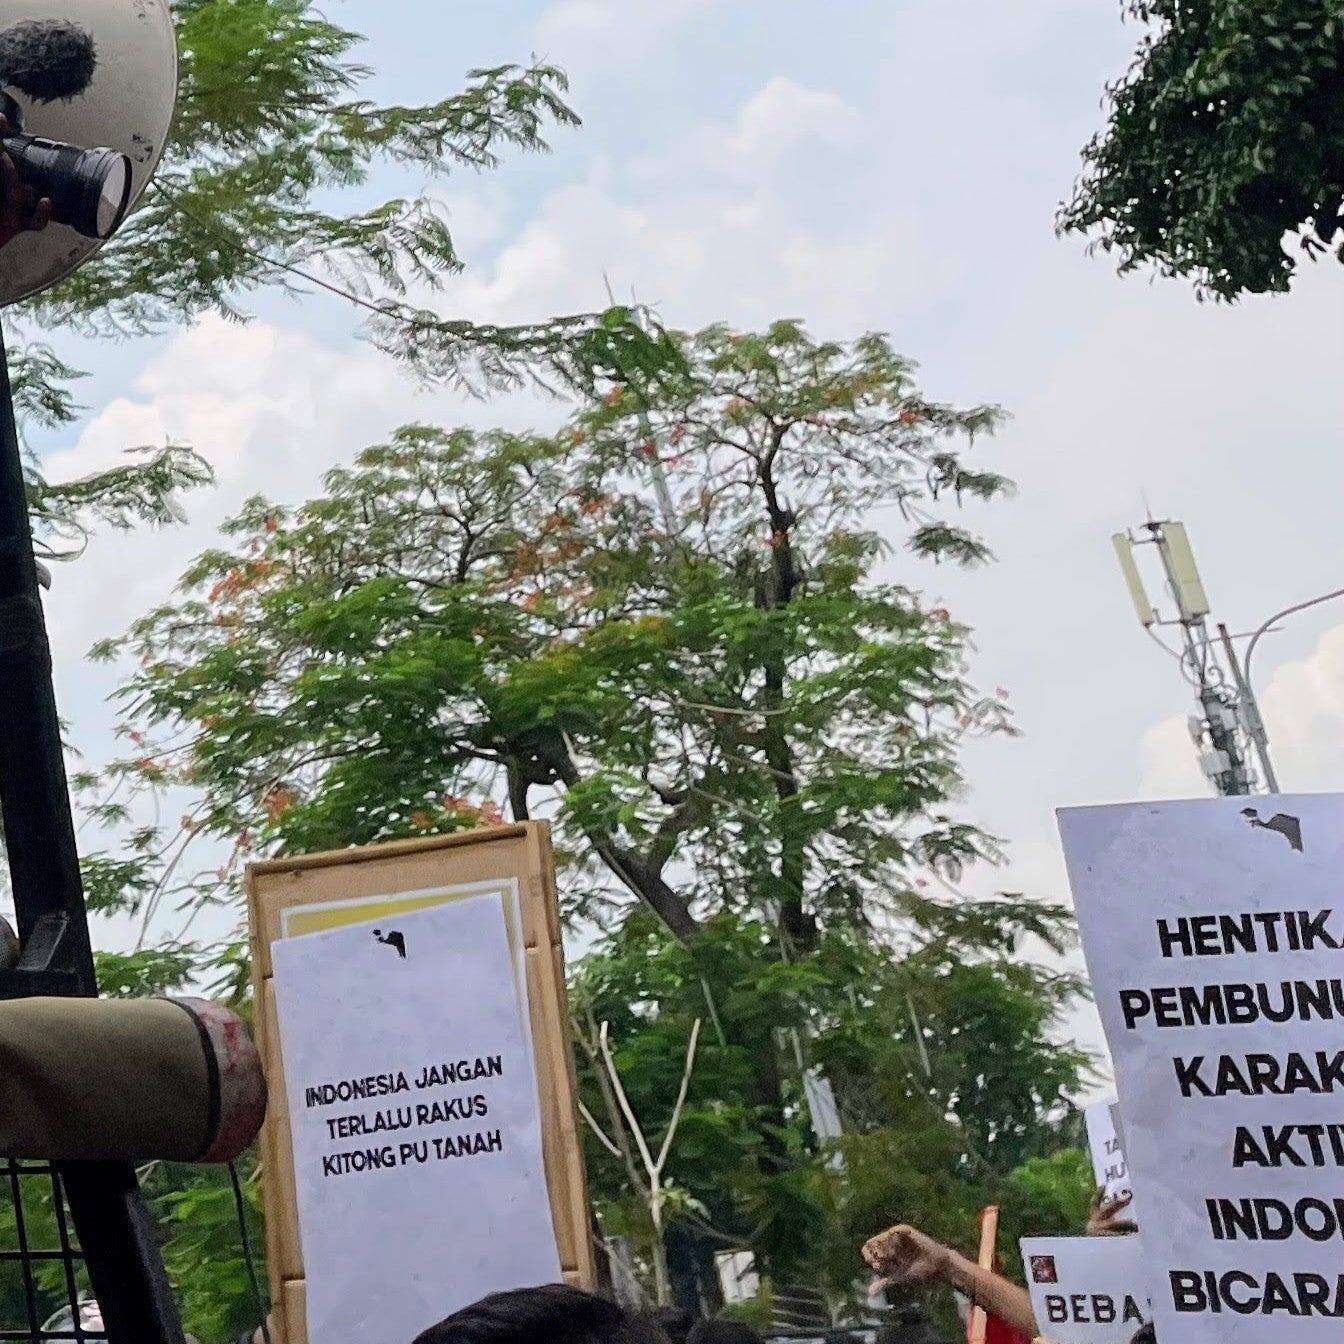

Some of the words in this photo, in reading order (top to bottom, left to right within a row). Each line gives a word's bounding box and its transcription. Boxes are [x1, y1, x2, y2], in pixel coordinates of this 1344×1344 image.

[1155, 908, 1344, 958] HENTIK
[305, 1071, 411, 1108] INDONESIA
[414, 1055, 503, 1089] JANGAN
[326, 1105, 412, 1140] TERLALU
[415, 1094, 488, 1126] RAKUS
[322, 1146, 397, 1177] KITONG
[399, 1139, 428, 1165] PU
[431, 1129, 503, 1159] TANAH
[1232, 1122, 1344, 1168] AKTI
[1204, 1197, 1344, 1242] INDO
